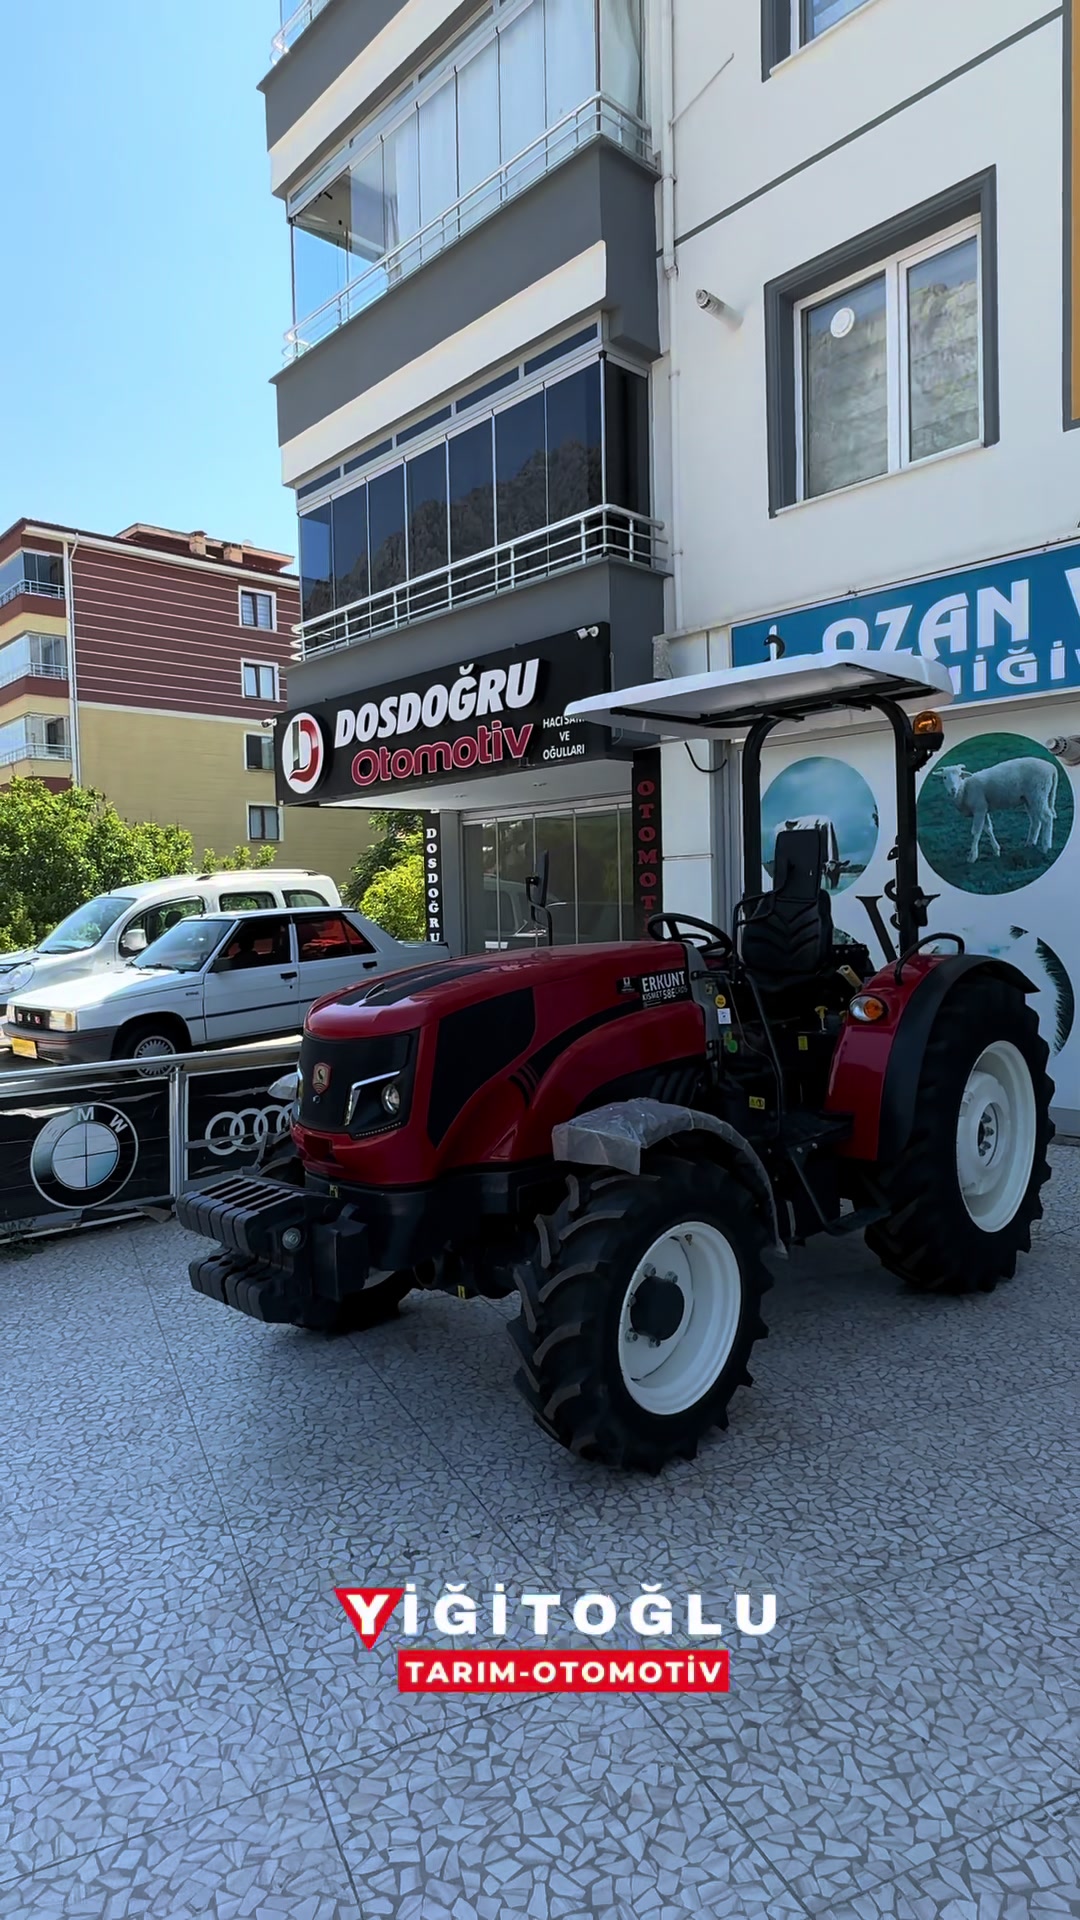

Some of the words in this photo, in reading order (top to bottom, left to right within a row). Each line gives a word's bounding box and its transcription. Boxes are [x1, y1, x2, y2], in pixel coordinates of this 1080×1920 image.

[822, 578, 1030, 661] OZAN
[334, 658, 541, 749] DOSDOĞRU
[543, 716, 563, 729] HACI
[350, 720, 534, 787] Otomotiv
[542, 744, 585, 760] OĞULLARI
[559, 730, 570, 742] VE
[426, 828, 441, 943] DOSDOĞRU
[641, 970, 685, 993] ERKUNT
